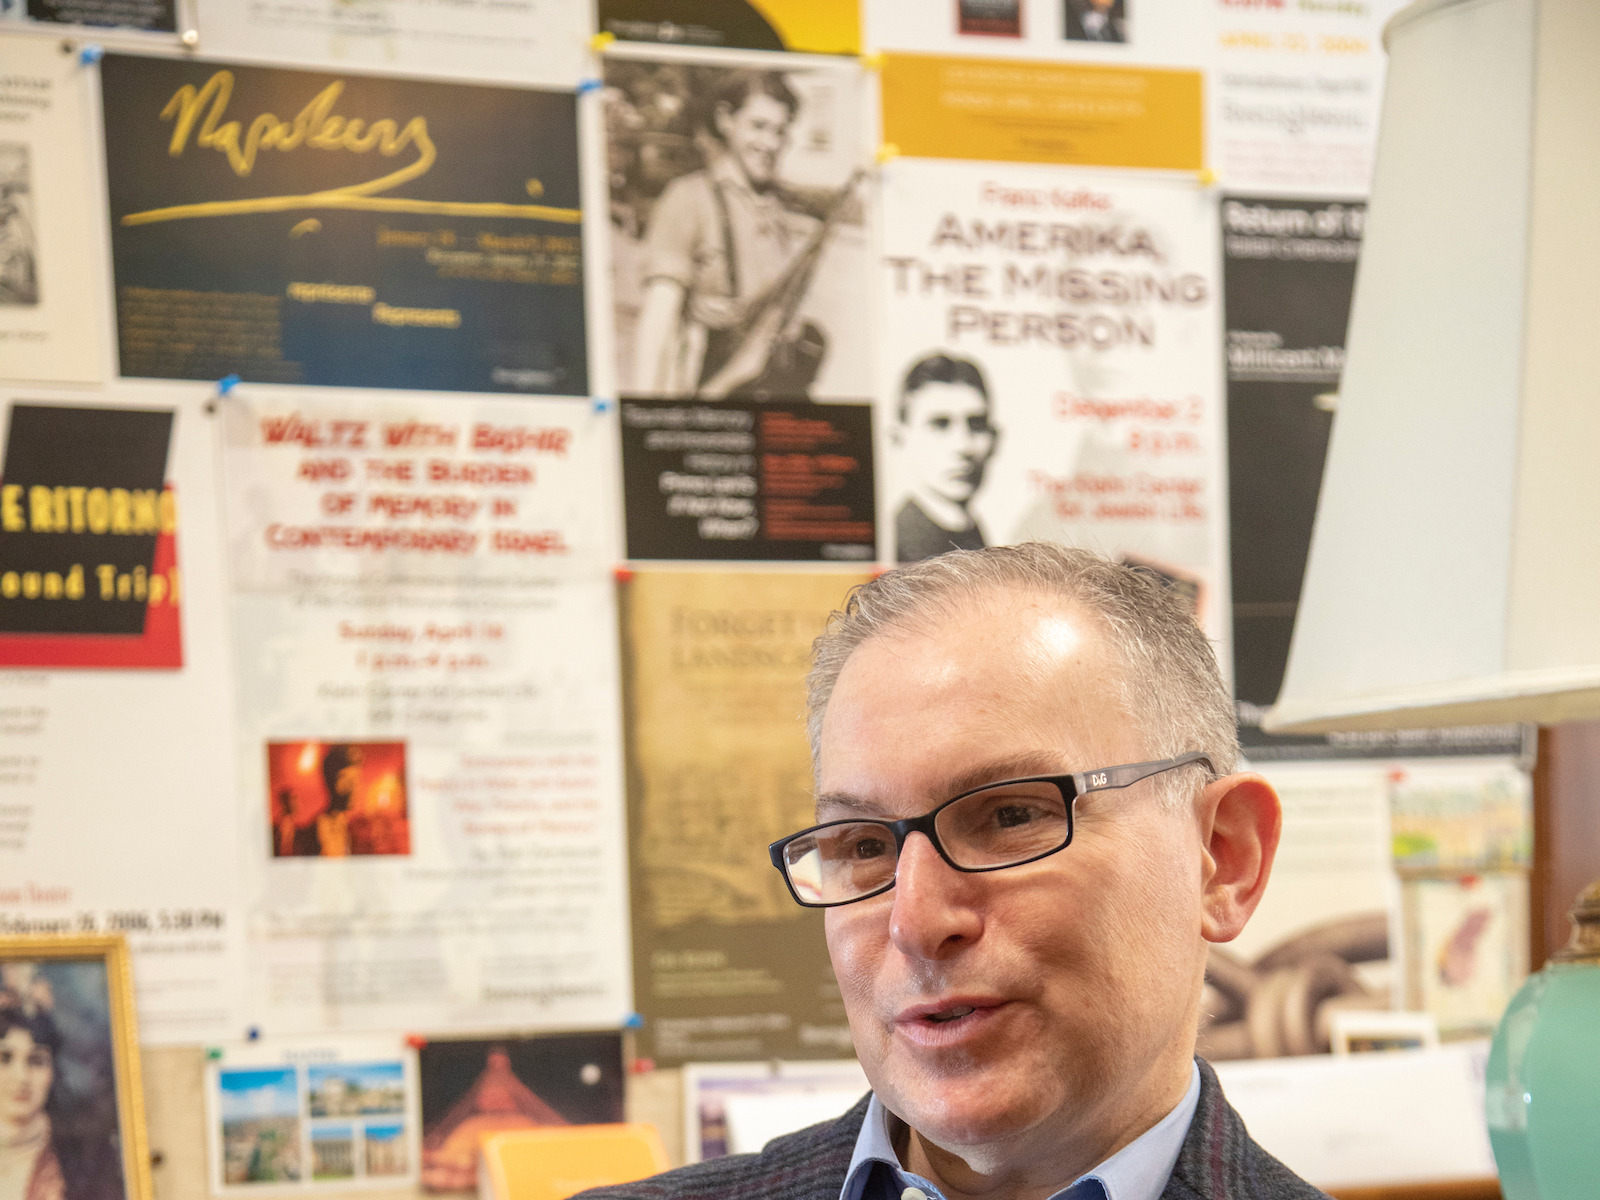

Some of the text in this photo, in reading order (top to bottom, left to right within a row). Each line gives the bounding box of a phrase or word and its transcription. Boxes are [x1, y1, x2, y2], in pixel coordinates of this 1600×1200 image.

[1227, 201, 1311, 236] Return
[931, 212, 1165, 264] AMERIKA
[884, 256, 1209, 308] THE MISSING
[948, 304, 1155, 349] PERSON
[261, 411, 573, 458] WALTZ WITH BASHIR
[297, 458, 535, 487] AND THE BURDEN
[1, 484, 177, 536] E RITORNO
[321, 491, 518, 521] OF MEMORY IN
[264, 524, 573, 558] CONTEMPORARY ISRAEL
[1, 564, 86, 600] ound
[671, 644, 810, 672] LANDSC
